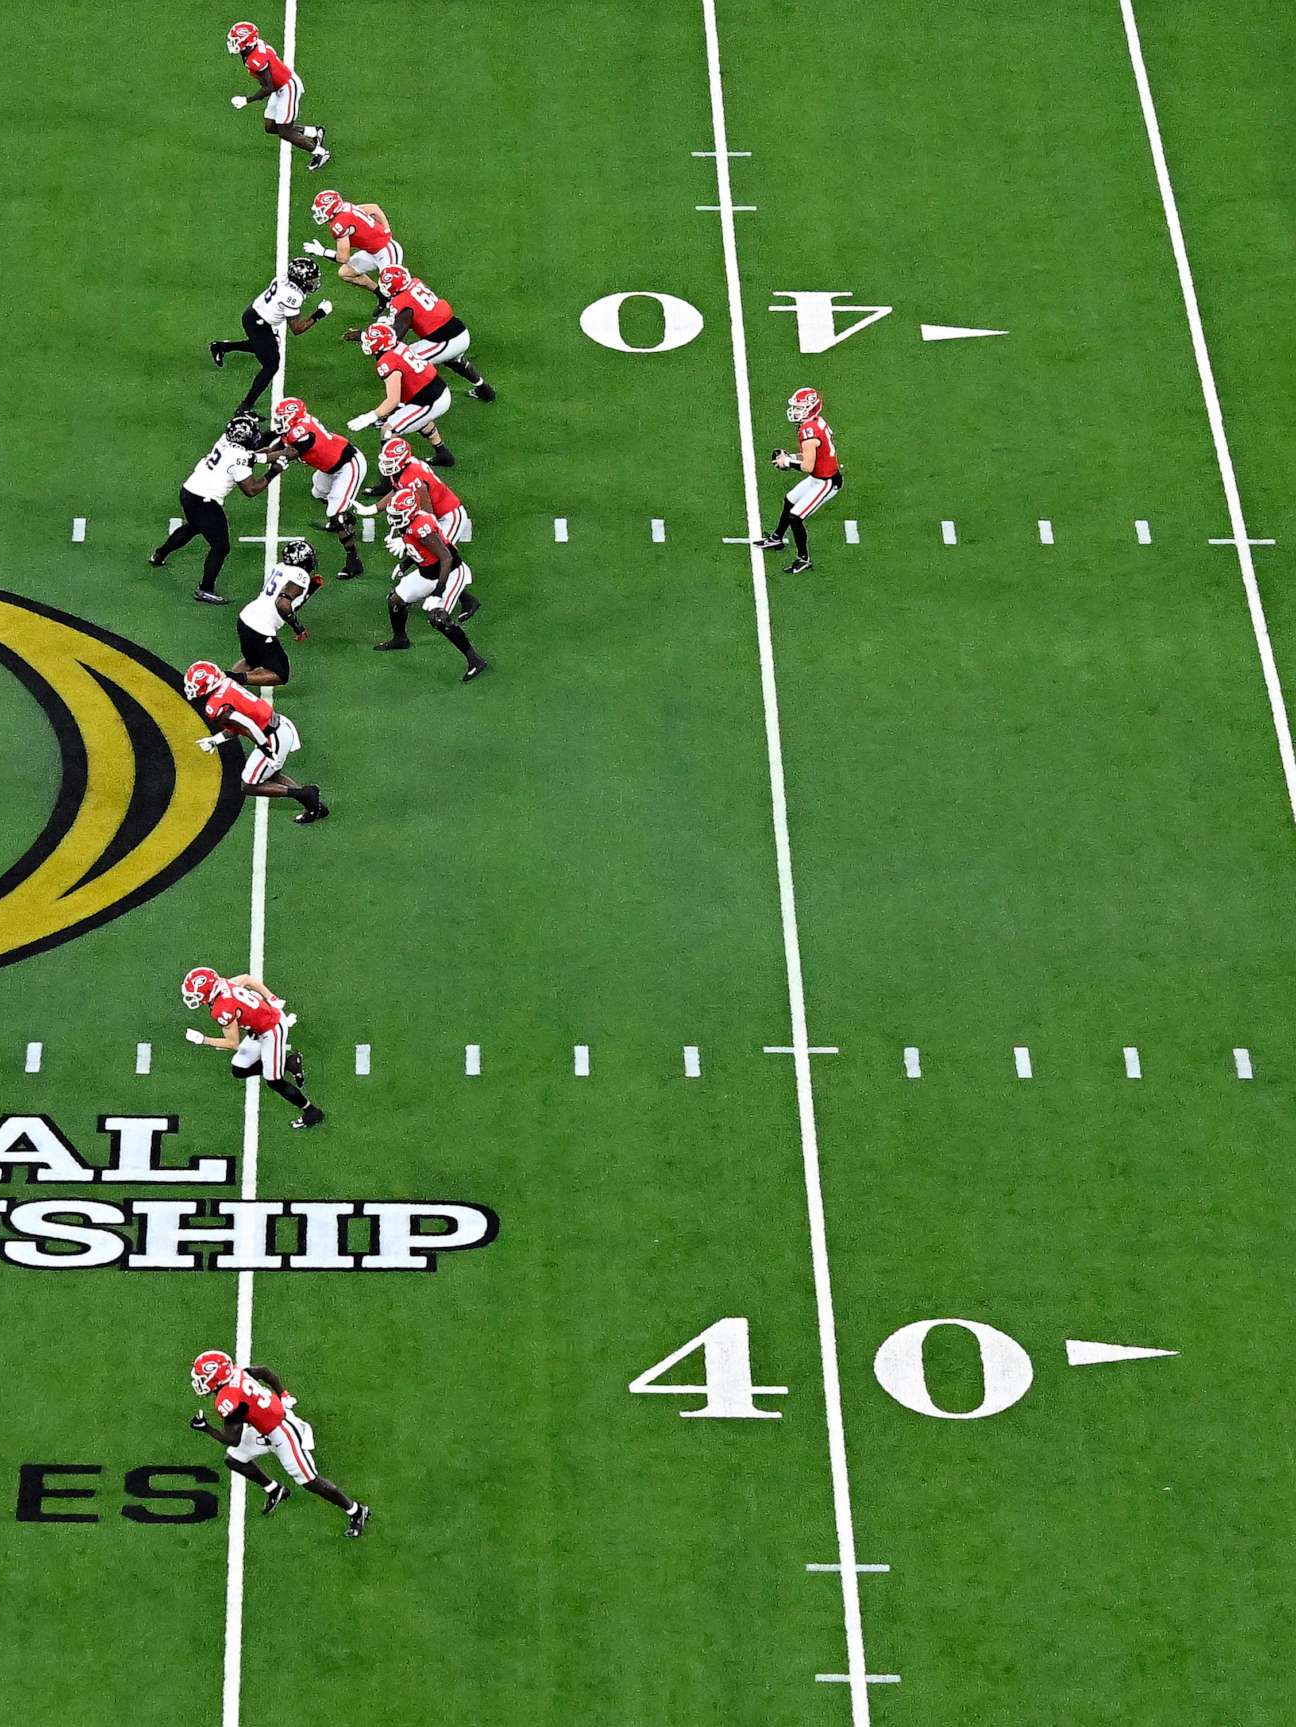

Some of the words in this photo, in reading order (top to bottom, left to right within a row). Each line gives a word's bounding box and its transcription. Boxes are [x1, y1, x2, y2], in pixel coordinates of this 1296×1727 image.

[252, 59, 261, 67] 1
[332, 222, 344, 235] 19
[264, 281, 278, 304] 8
[287, 296, 297, 306] 98
[377, 363, 390, 376] 69
[293, 426, 306, 438] 63
[802, 427, 814, 439] 13
[206, 448, 222, 470] 2
[236, 458, 247, 466] 52
[408, 478, 422, 492] 73
[417, 523, 432, 538] 59
[297, 573, 308, 584] 95
[206, 705, 214, 715] 0
[217, 1011, 232, 1025] 84
[241, 1371, 273, 1409] 3
[217, 1399, 234, 1417] 30
